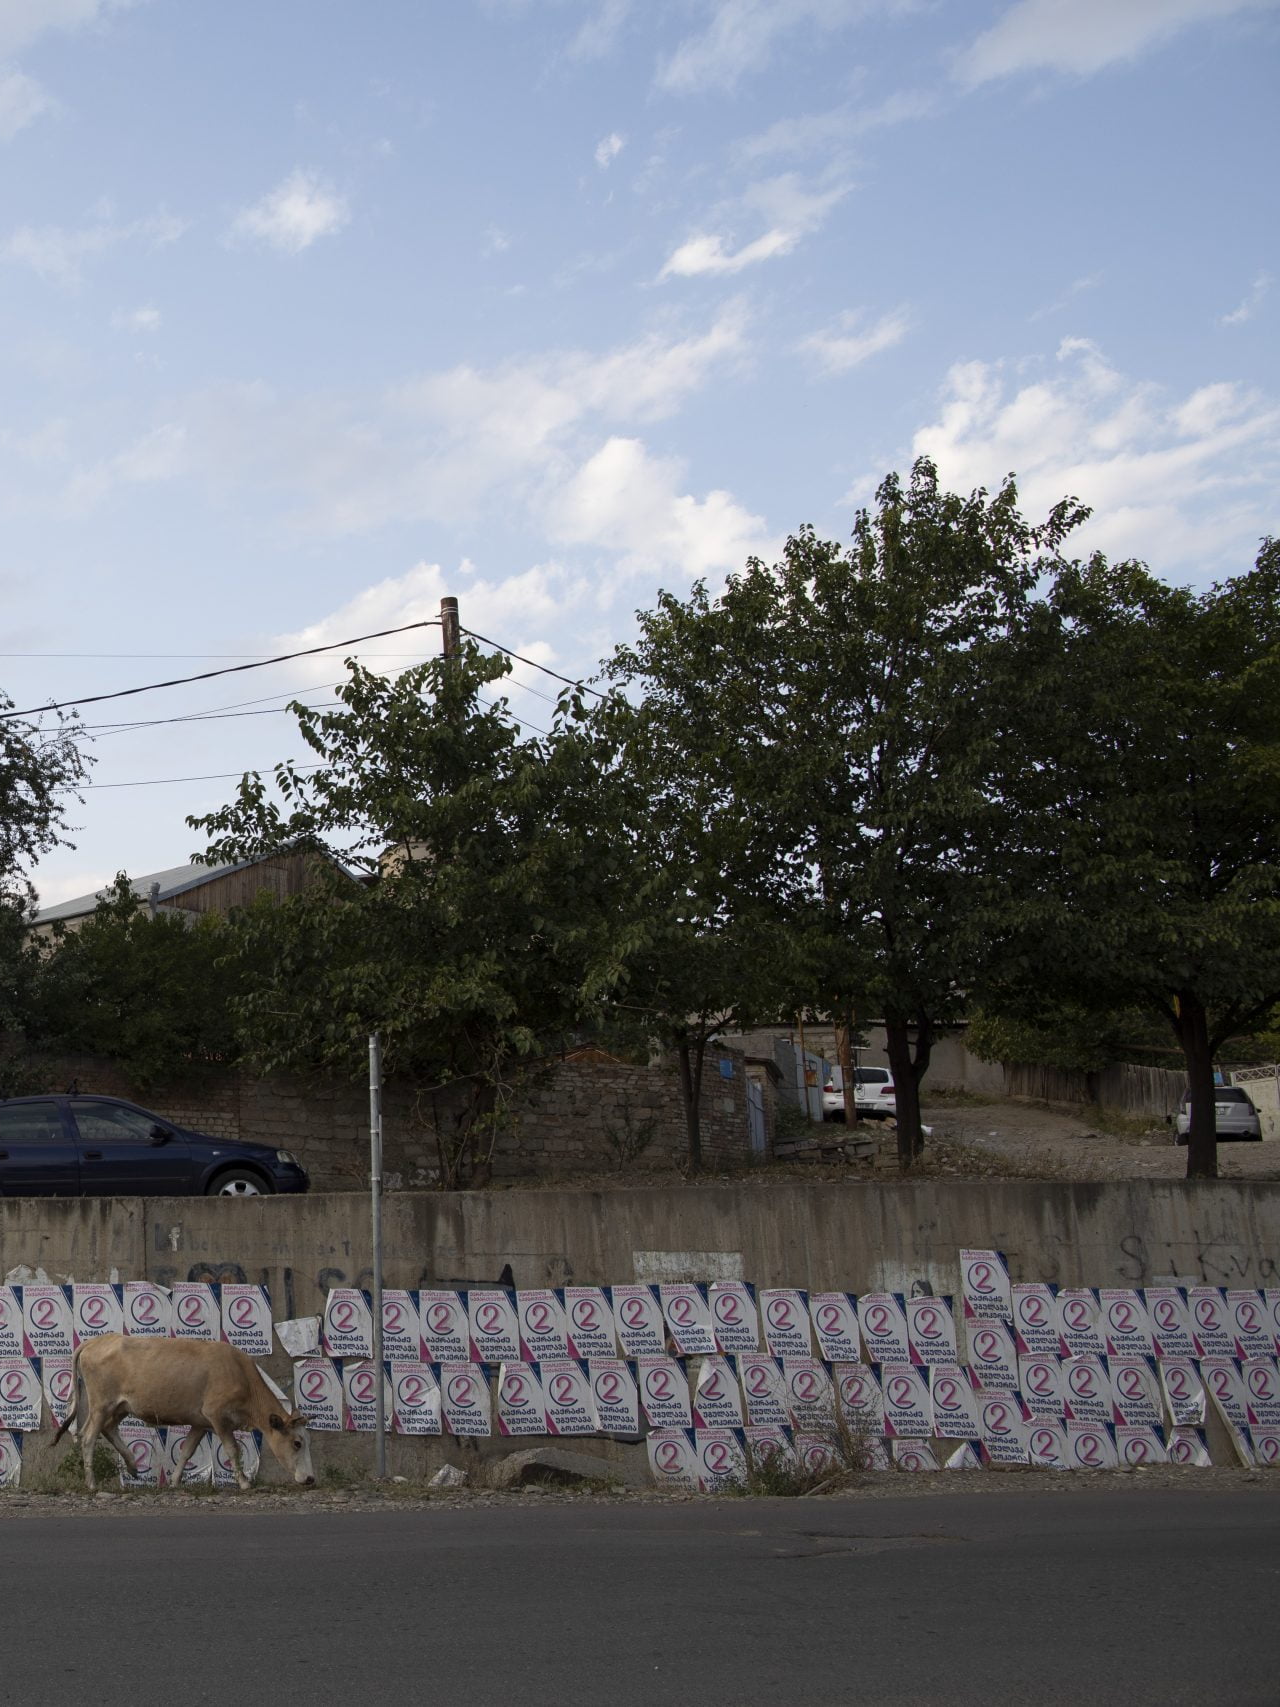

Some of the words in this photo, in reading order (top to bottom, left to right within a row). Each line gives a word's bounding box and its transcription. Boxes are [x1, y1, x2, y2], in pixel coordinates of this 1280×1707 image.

[975, 1265, 990, 1289] 2
[37, 1301, 53, 1325] 2
[434, 1306, 449, 1331] 2
[483, 1306, 498, 1330] 2
[579, 1302, 594, 1327] 2
[627, 1300, 643, 1325] 2
[721, 1296, 737, 1321] 2
[774, 1301, 790, 1326] 2
[980, 1333, 996, 1358] 2
[455, 1378, 471, 1403] 2
[556, 1376, 572, 1402] 2
[894, 1379, 910, 1404] 2
[940, 1381, 956, 1406] 2
